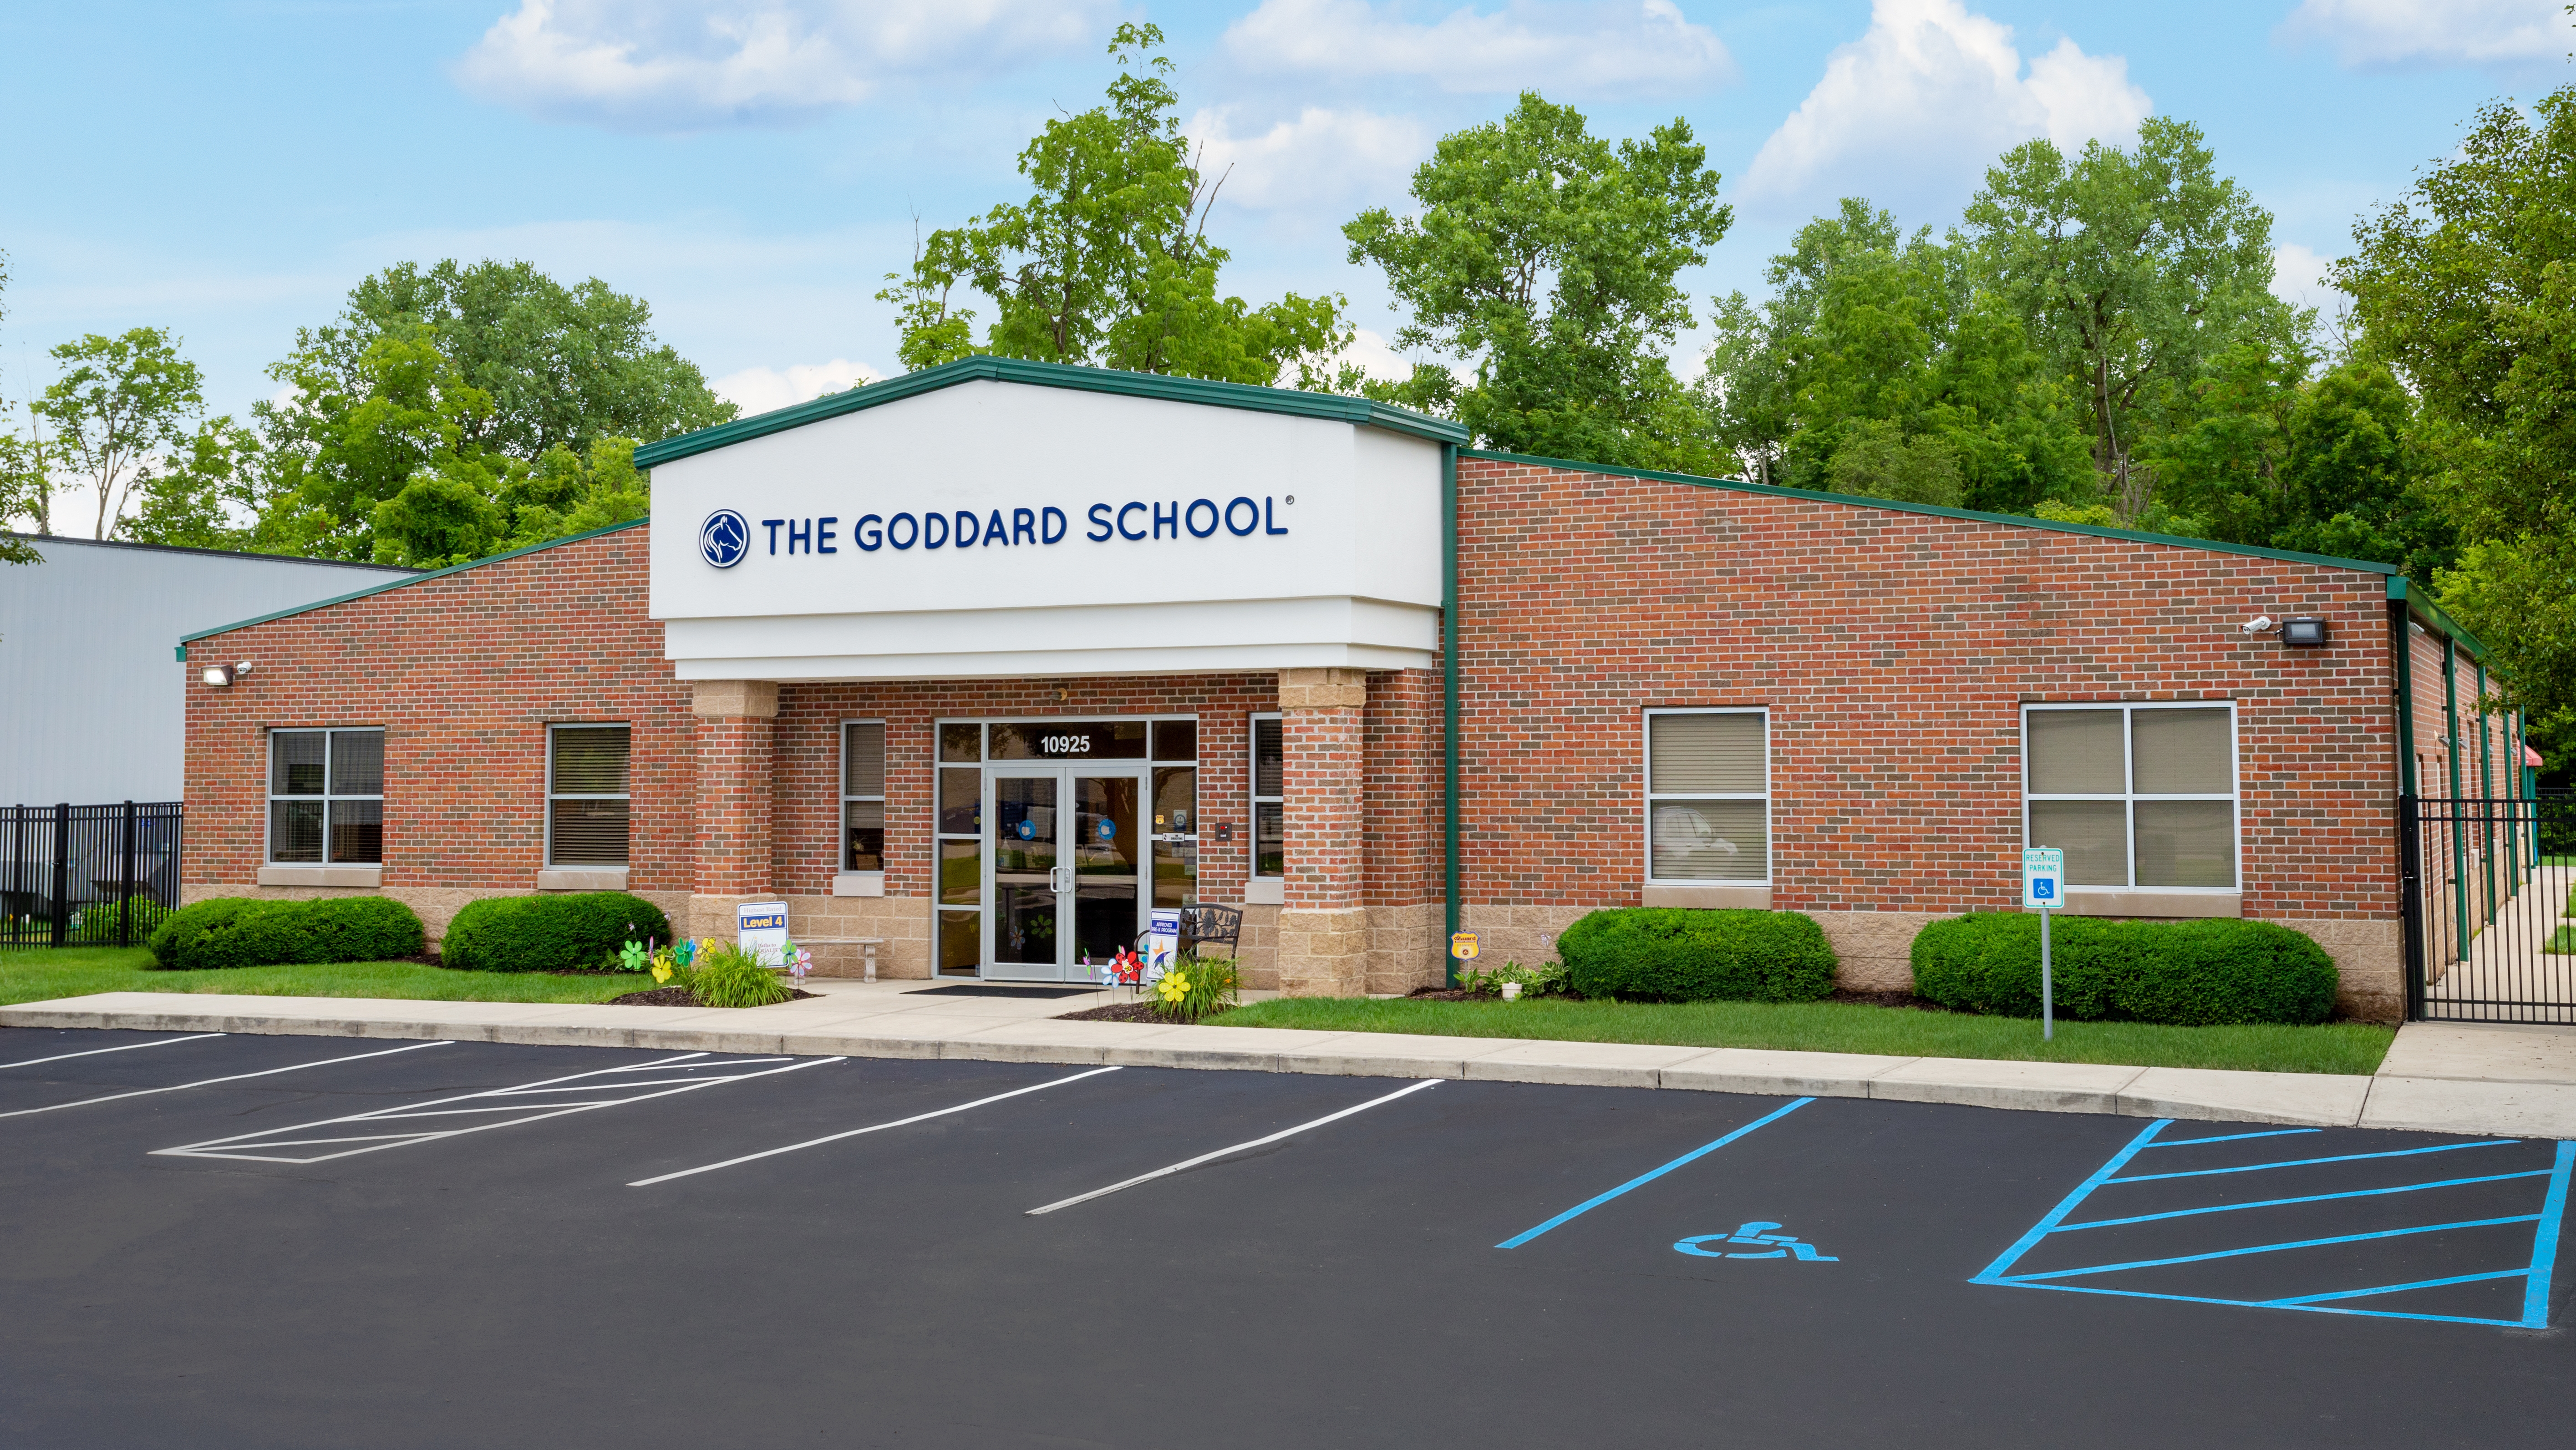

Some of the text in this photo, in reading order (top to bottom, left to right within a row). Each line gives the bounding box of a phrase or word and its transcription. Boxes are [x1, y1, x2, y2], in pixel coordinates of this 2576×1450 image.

[762, 496, 1289, 555] THE GODDARD SCHOOL
[1041, 735, 1090, 753] 10925
[743, 916, 782, 928] Level 4
